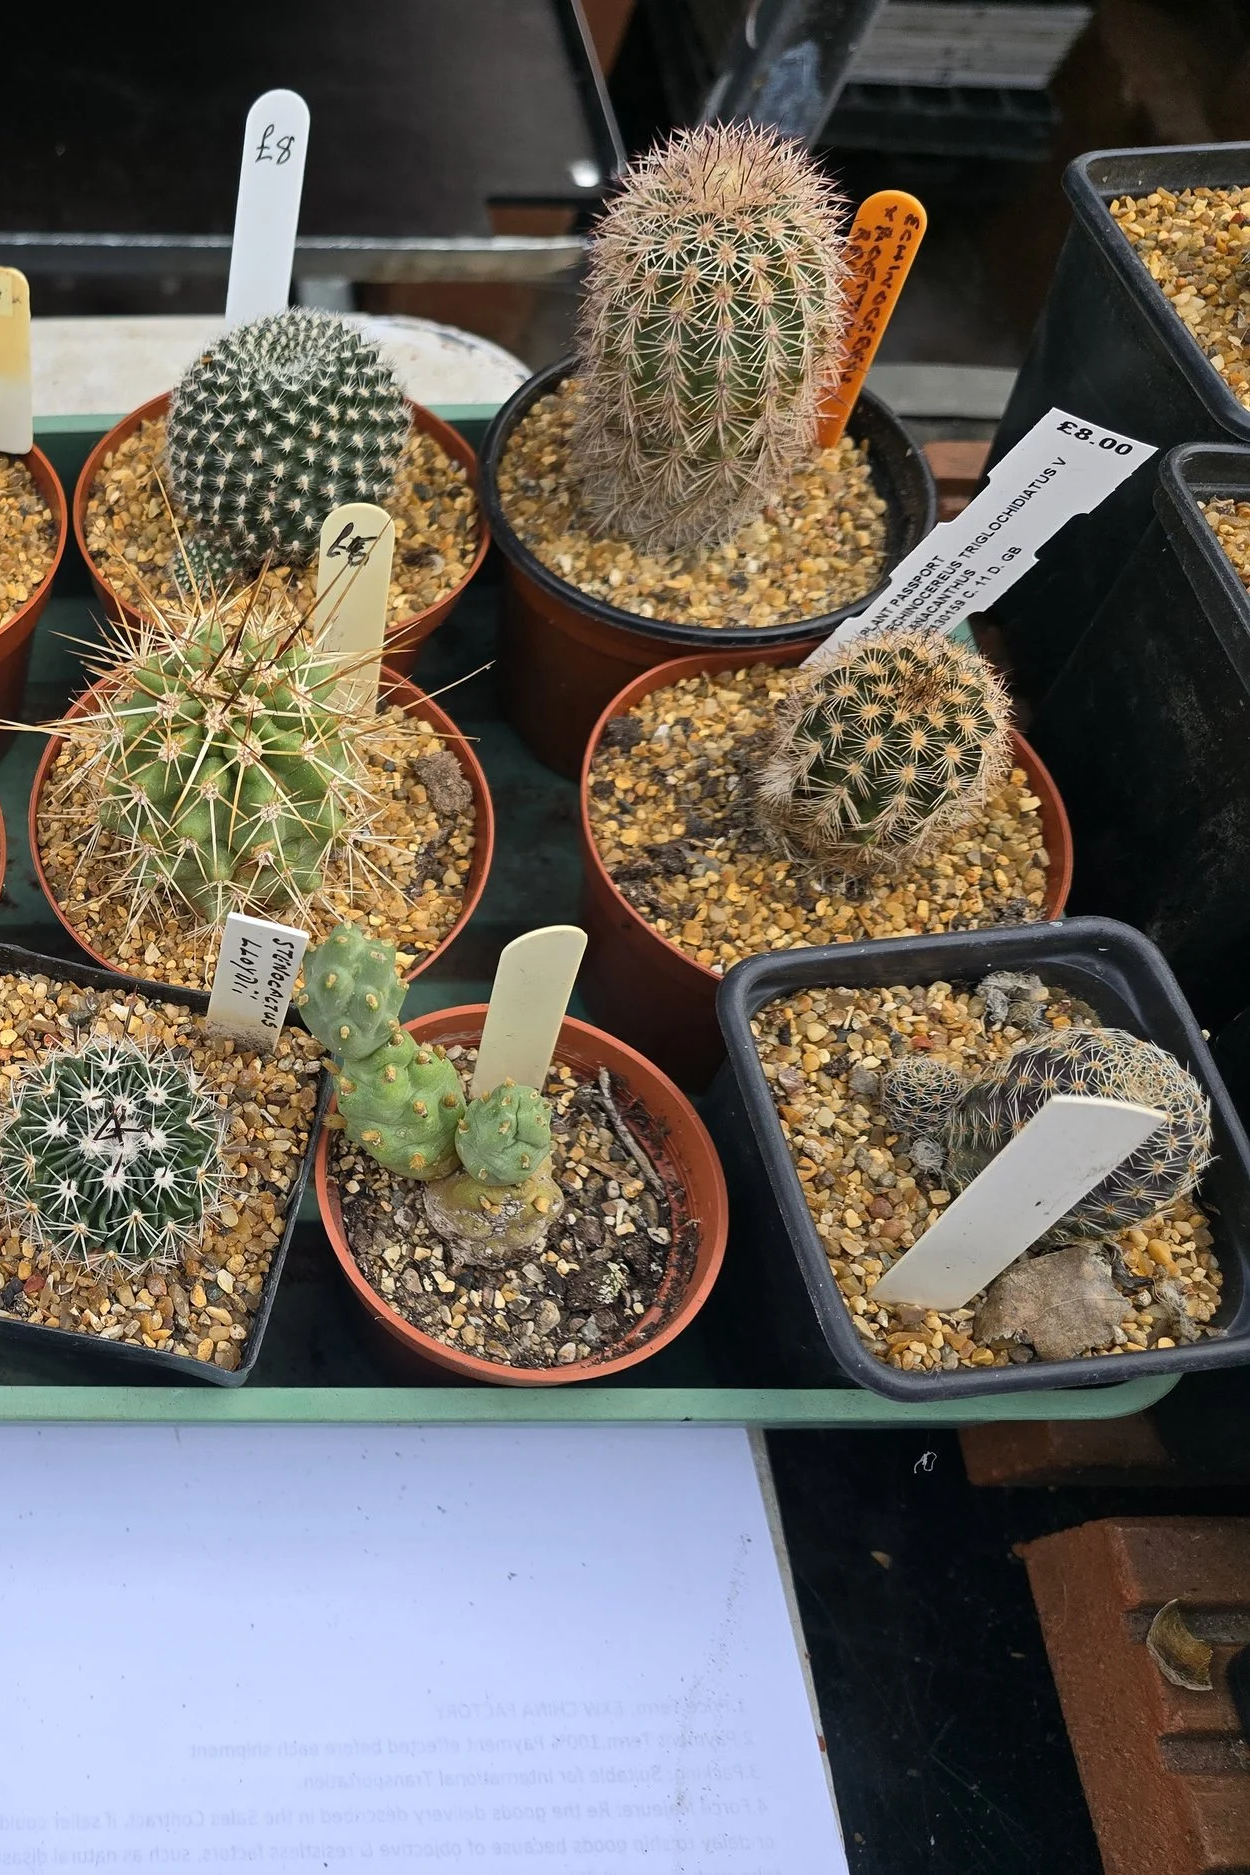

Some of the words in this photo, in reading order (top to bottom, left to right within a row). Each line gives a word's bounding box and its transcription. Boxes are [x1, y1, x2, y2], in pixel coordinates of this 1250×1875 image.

[255, 124, 295, 165] £8
[1056, 420, 1134, 456] £8.00
[958, 466, 1057, 561] TRIGLOCHIDIATUS
[1051, 456, 1067, 466] V
[890, 555, 945, 607] PASSPORT
[964, 589, 978, 600] C.
[975, 574, 992, 589] 11
[988, 565, 1005, 575] D.
[1001, 545, 1022, 562] GB
[908, 569, 977, 631] ANACANTHUS
